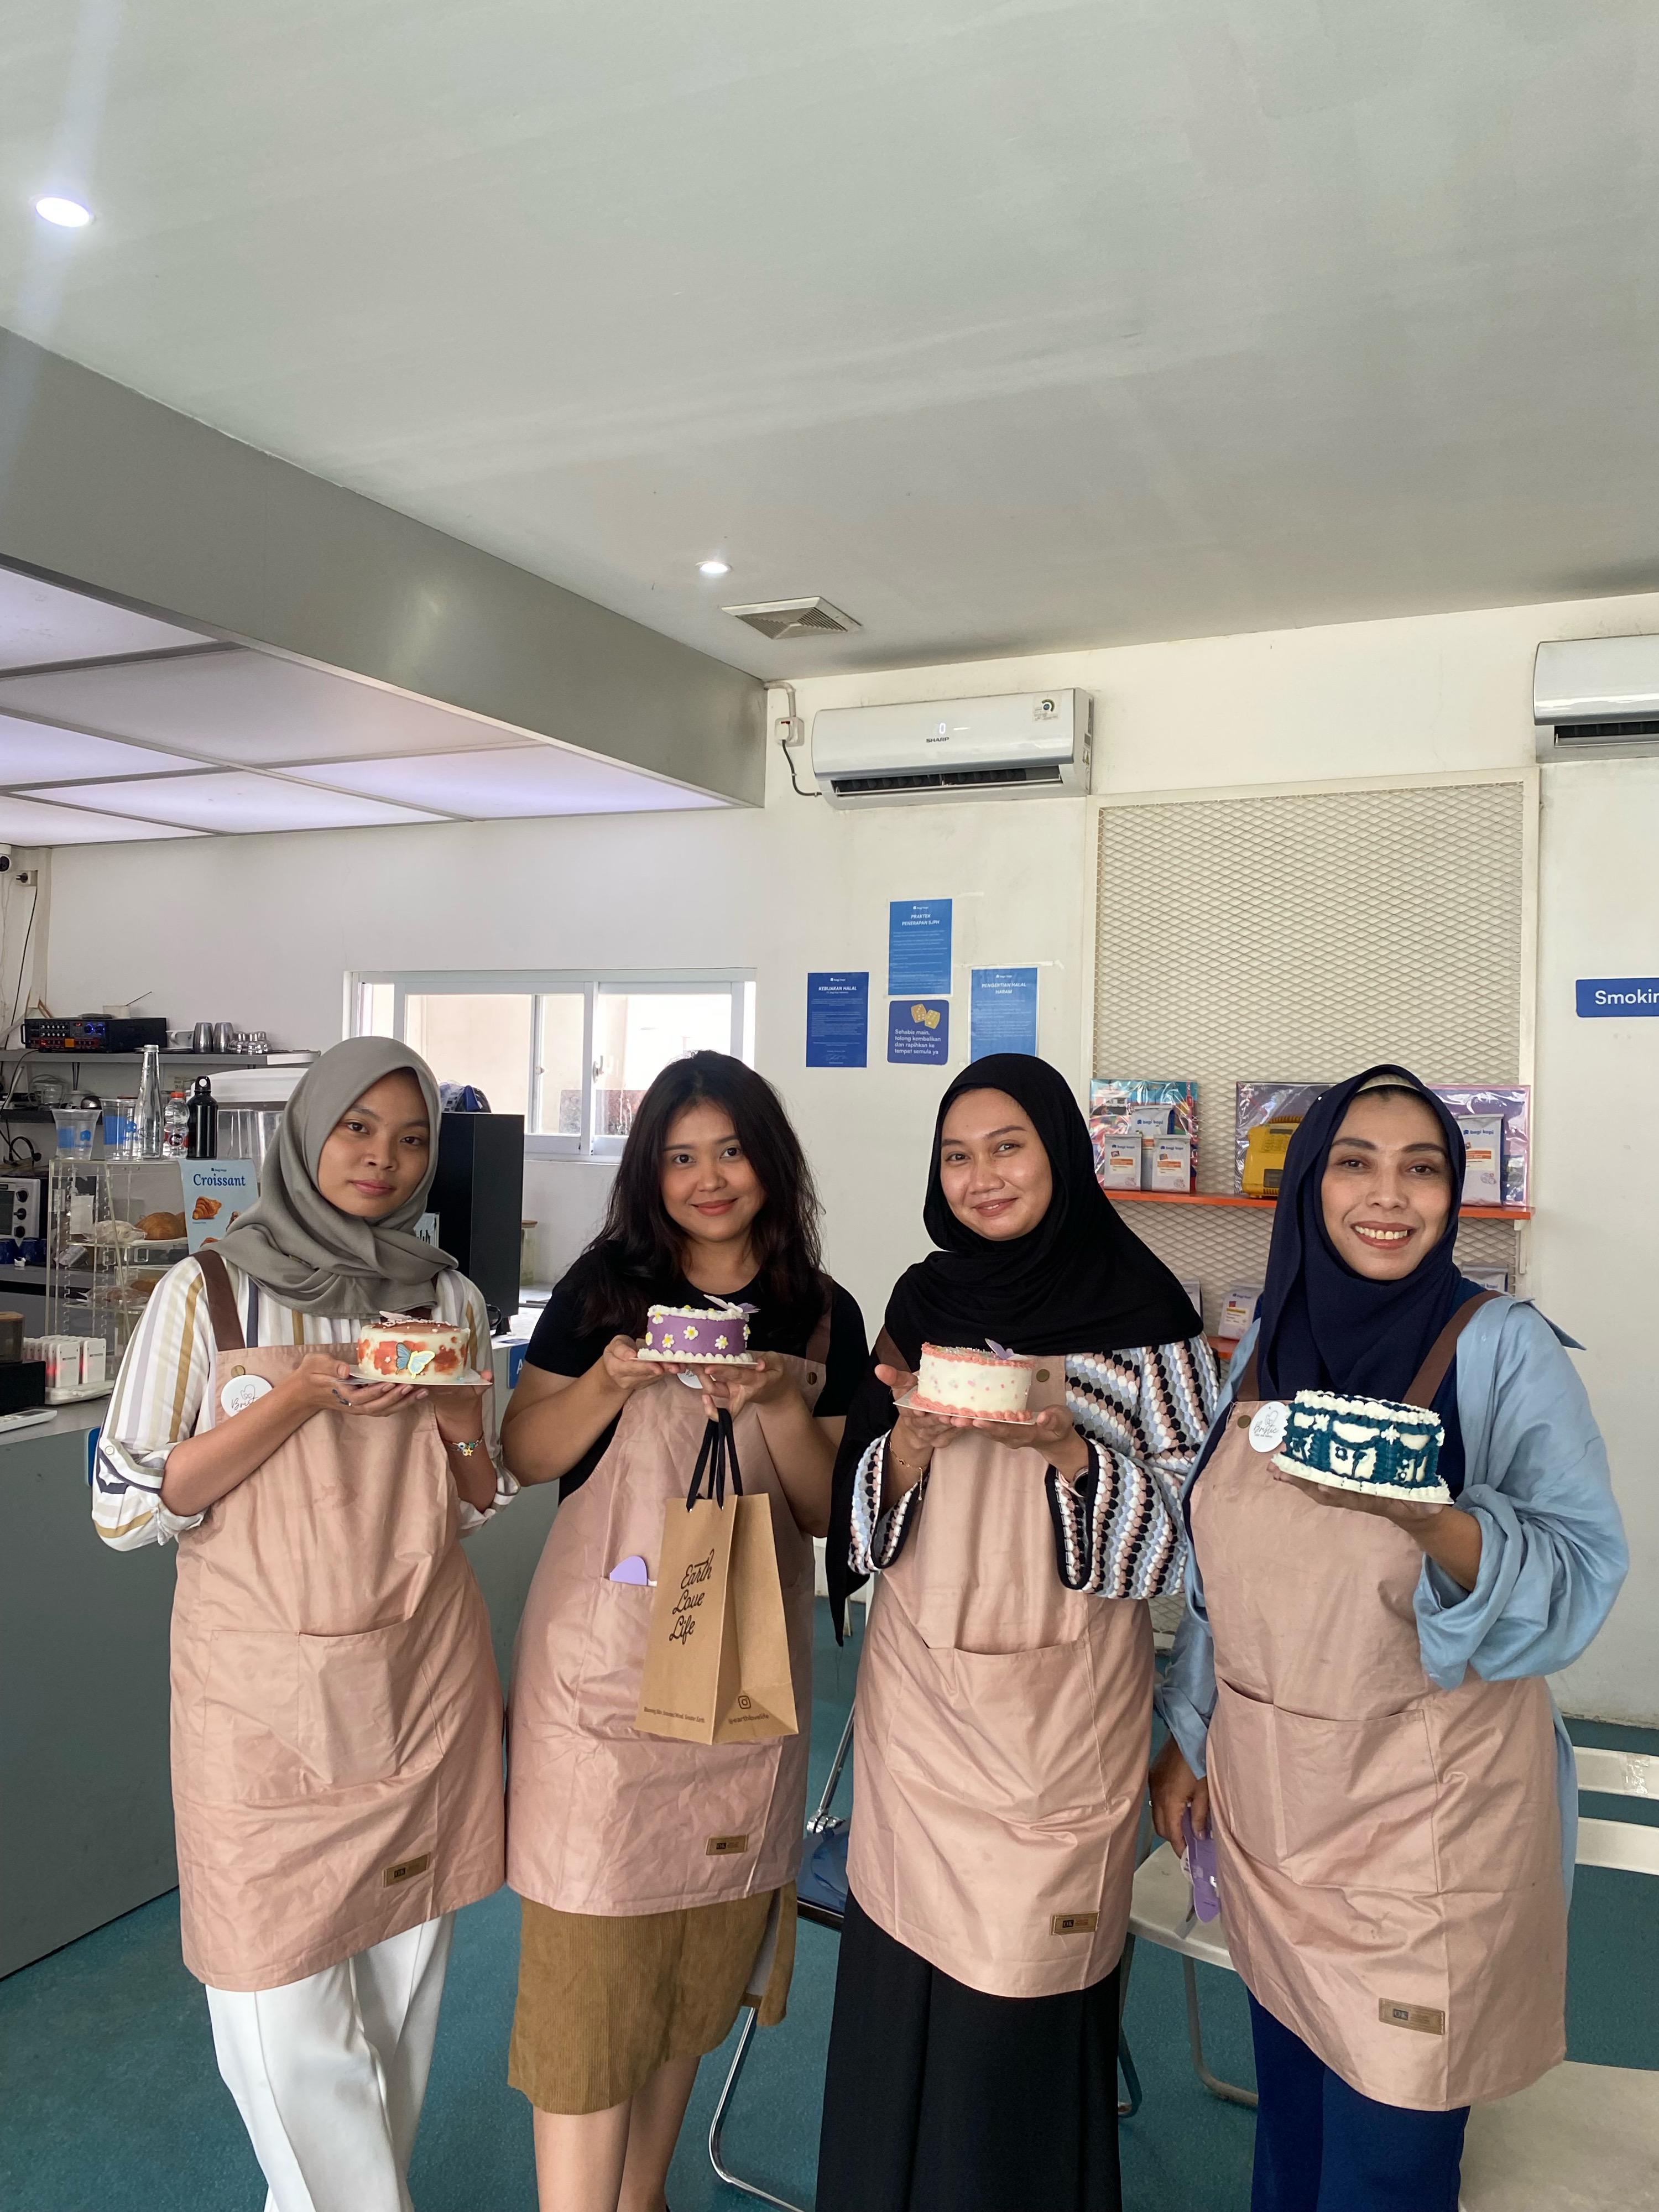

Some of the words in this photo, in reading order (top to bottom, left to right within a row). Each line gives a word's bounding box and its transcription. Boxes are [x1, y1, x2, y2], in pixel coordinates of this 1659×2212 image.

[193, 1173, 246, 1186] Croissant
[681, 1548, 714, 1589] Earth
[672, 1589, 705, 1615] Love
[669, 1615, 695, 1645] Life
